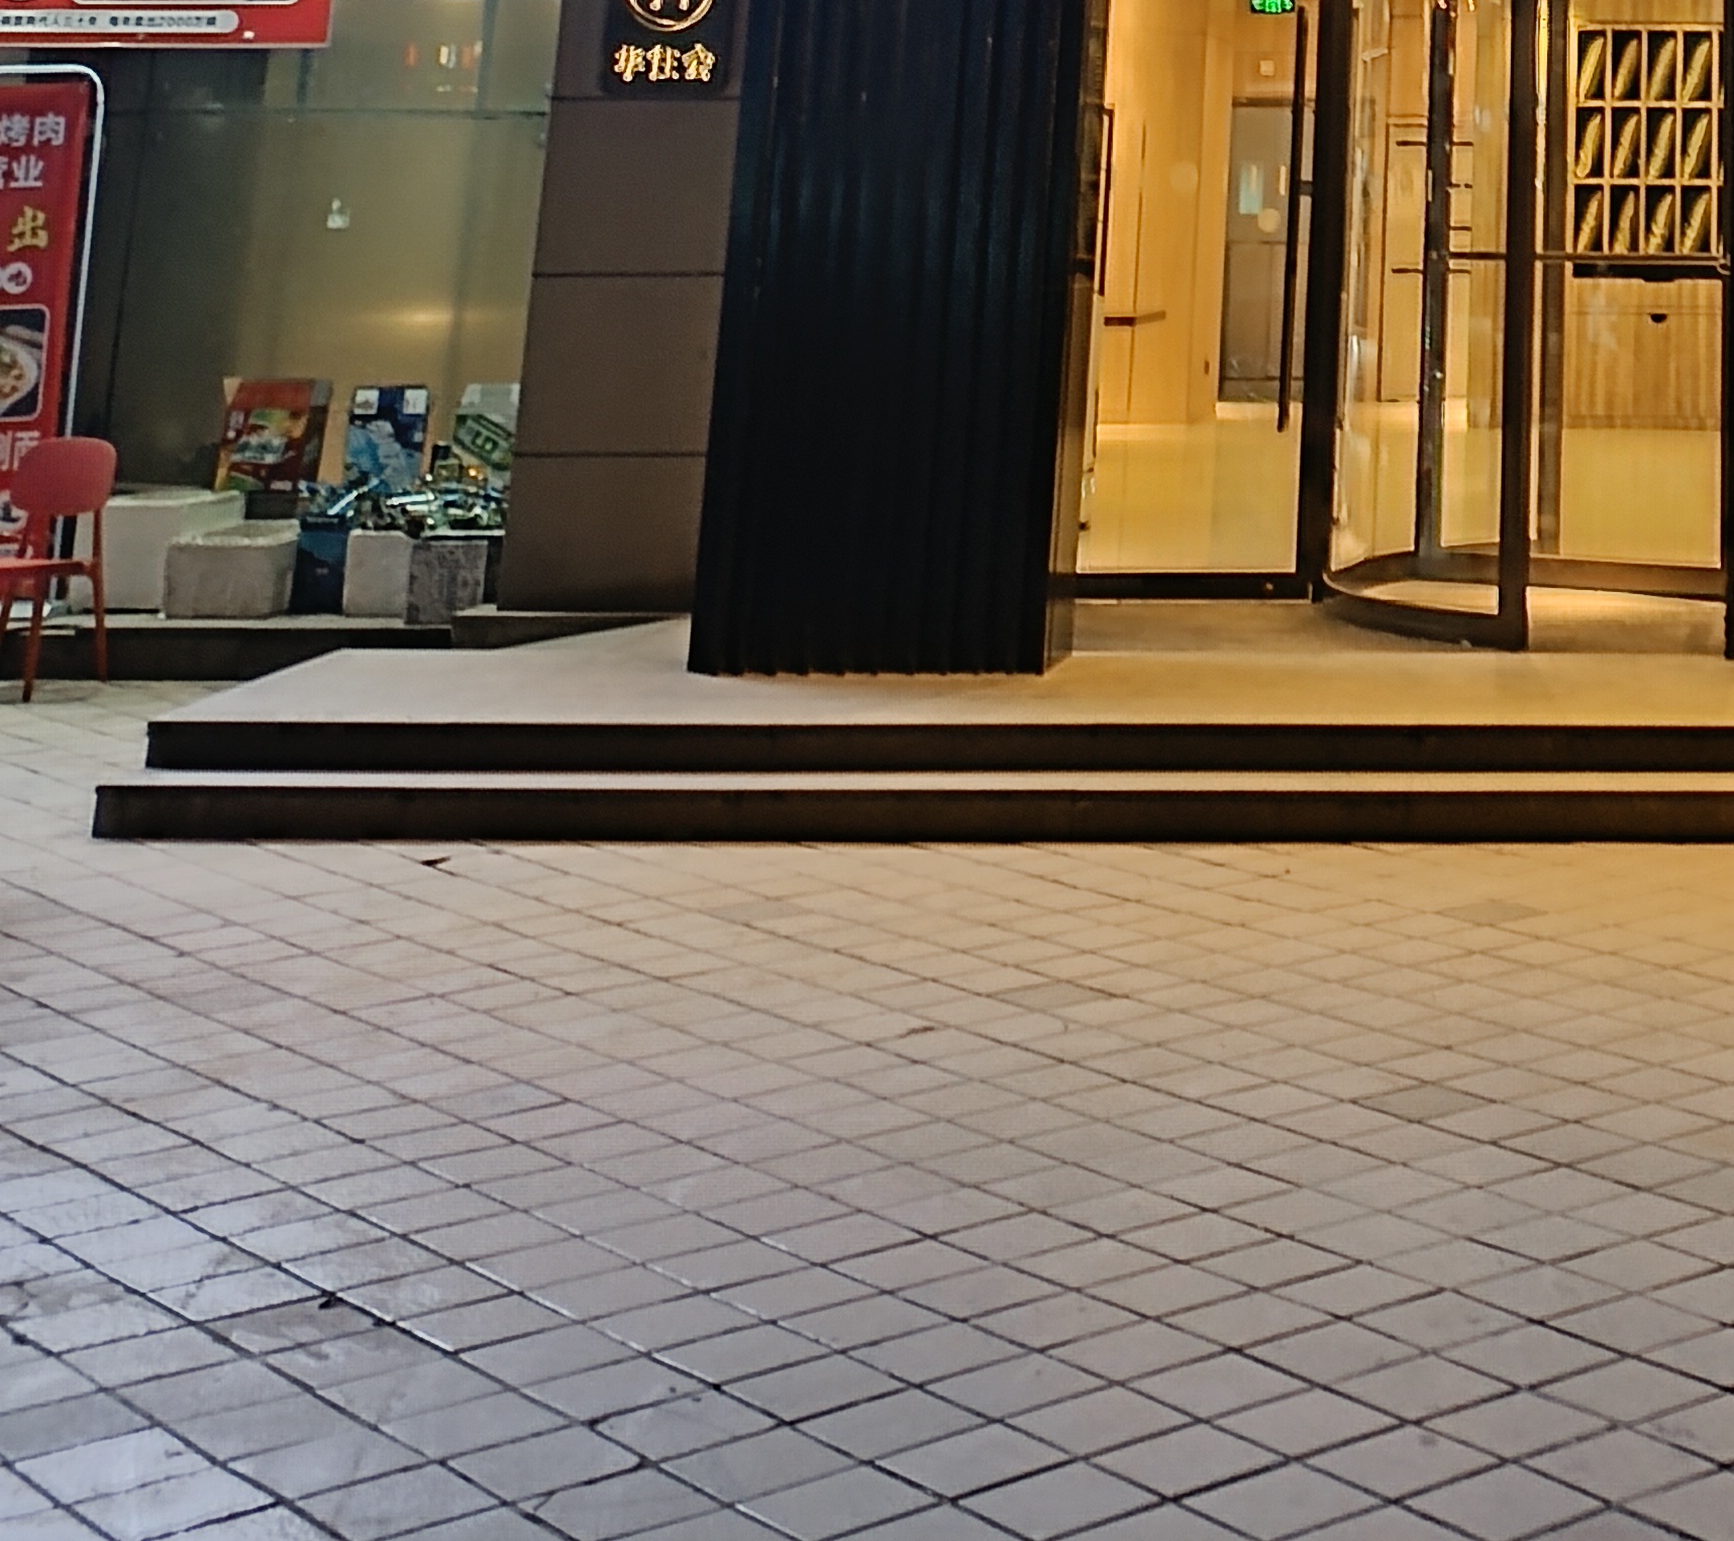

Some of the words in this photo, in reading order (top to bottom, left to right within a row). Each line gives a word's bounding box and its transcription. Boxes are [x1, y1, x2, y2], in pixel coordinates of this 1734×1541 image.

[613, 42, 716, 83] 华住会
[0, 153, 45, 189] 业
